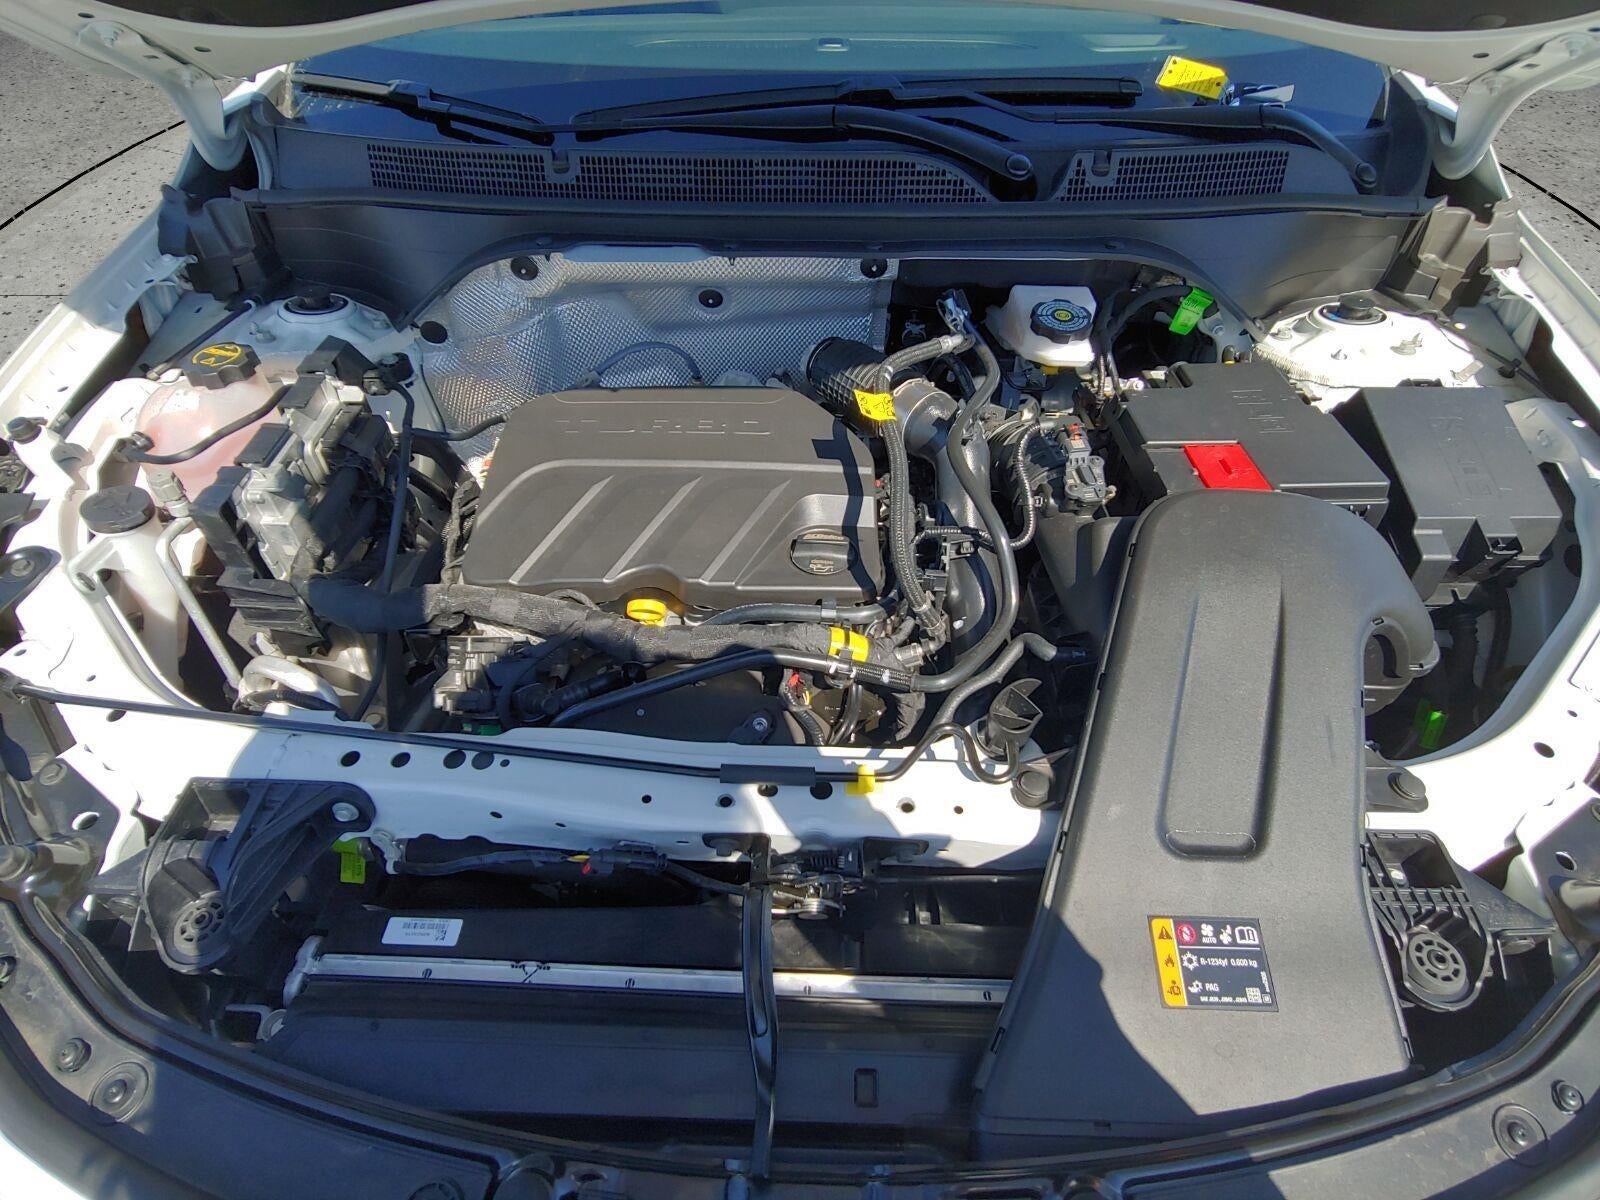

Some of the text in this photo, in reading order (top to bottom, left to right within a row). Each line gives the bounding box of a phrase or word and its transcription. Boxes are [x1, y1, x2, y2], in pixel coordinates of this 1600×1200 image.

[1202, 936, 1217, 944] AUTO
[1200, 957, 1228, 968] R-1234yf
[1249, 959, 1258, 968] kg
[1205, 982, 1219, 992] PAG
